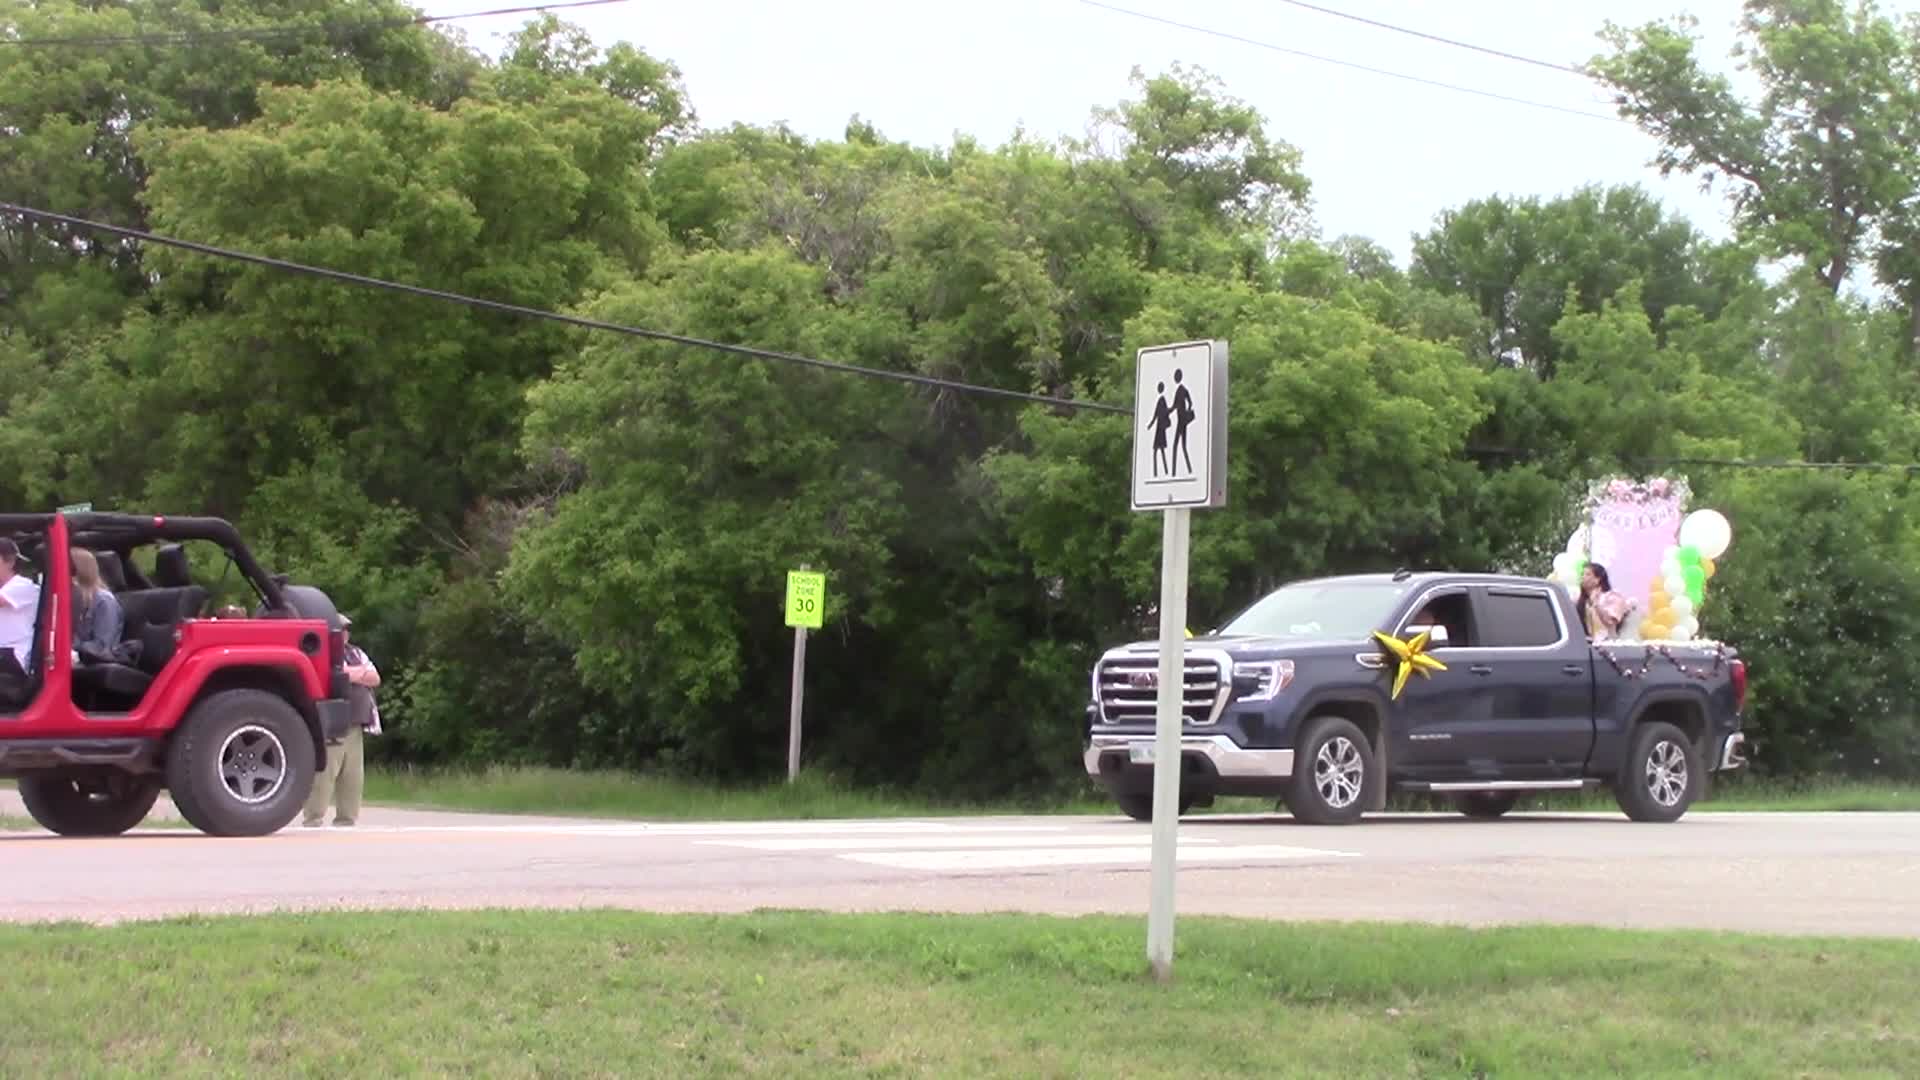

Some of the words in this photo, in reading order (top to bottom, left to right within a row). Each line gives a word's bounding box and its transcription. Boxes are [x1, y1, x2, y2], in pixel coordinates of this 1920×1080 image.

[792, 576, 820, 586] SCHOOL
[796, 586, 815, 595] ZONE
[796, 598, 814, 612] 30
